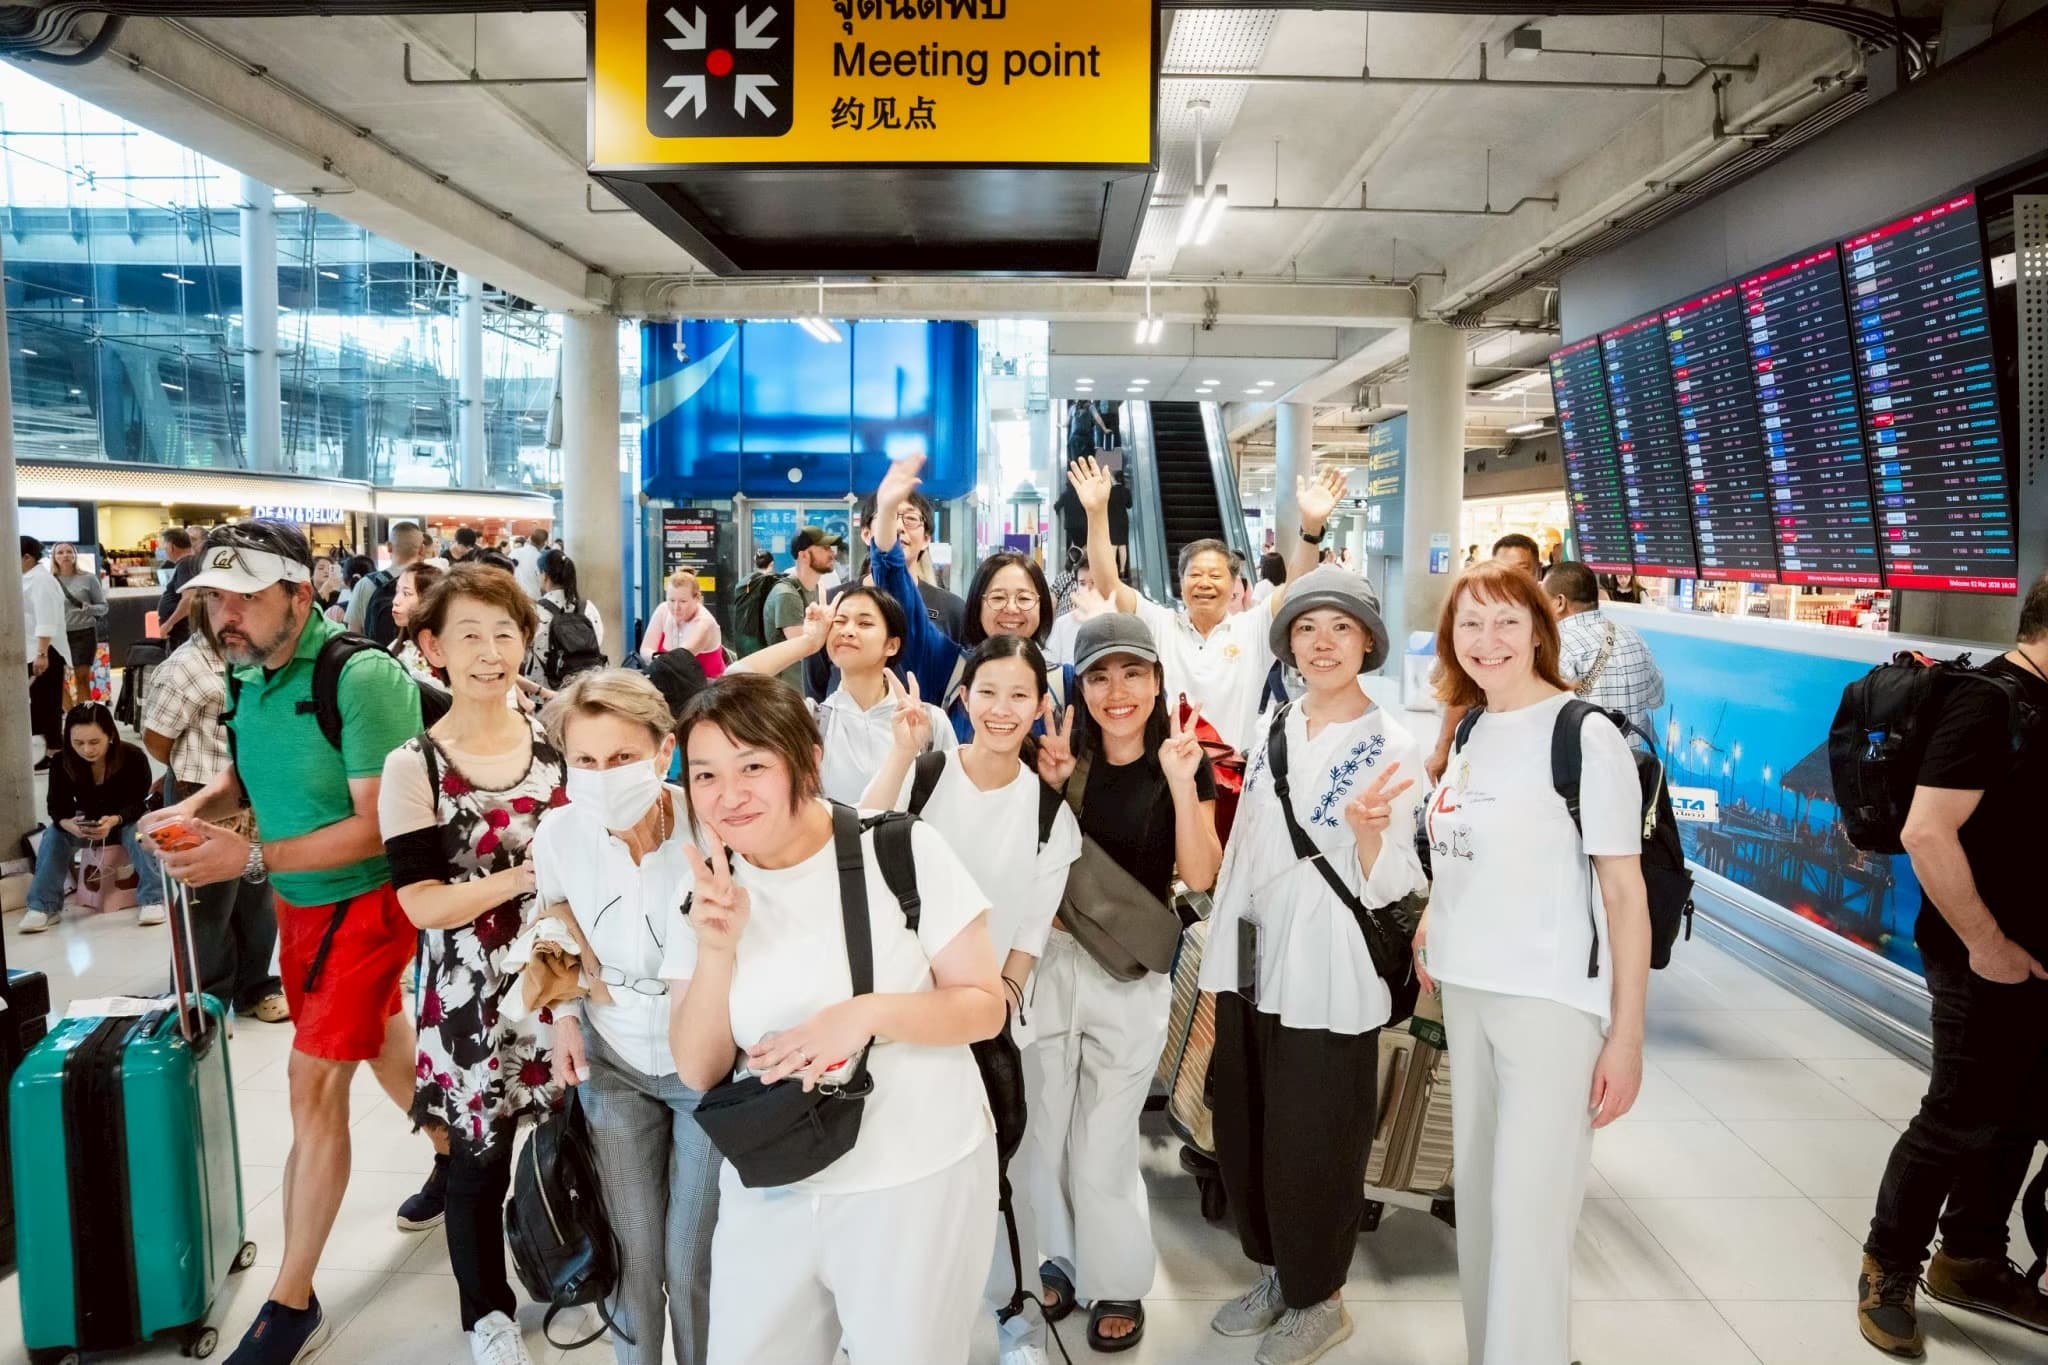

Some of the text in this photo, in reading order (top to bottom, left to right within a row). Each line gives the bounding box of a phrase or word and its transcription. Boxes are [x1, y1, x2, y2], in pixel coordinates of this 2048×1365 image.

[832, 42, 1101, 85] Meeting point
[831, 96, 938, 130] 约见点
[212, 551, 239, 569] Cal
